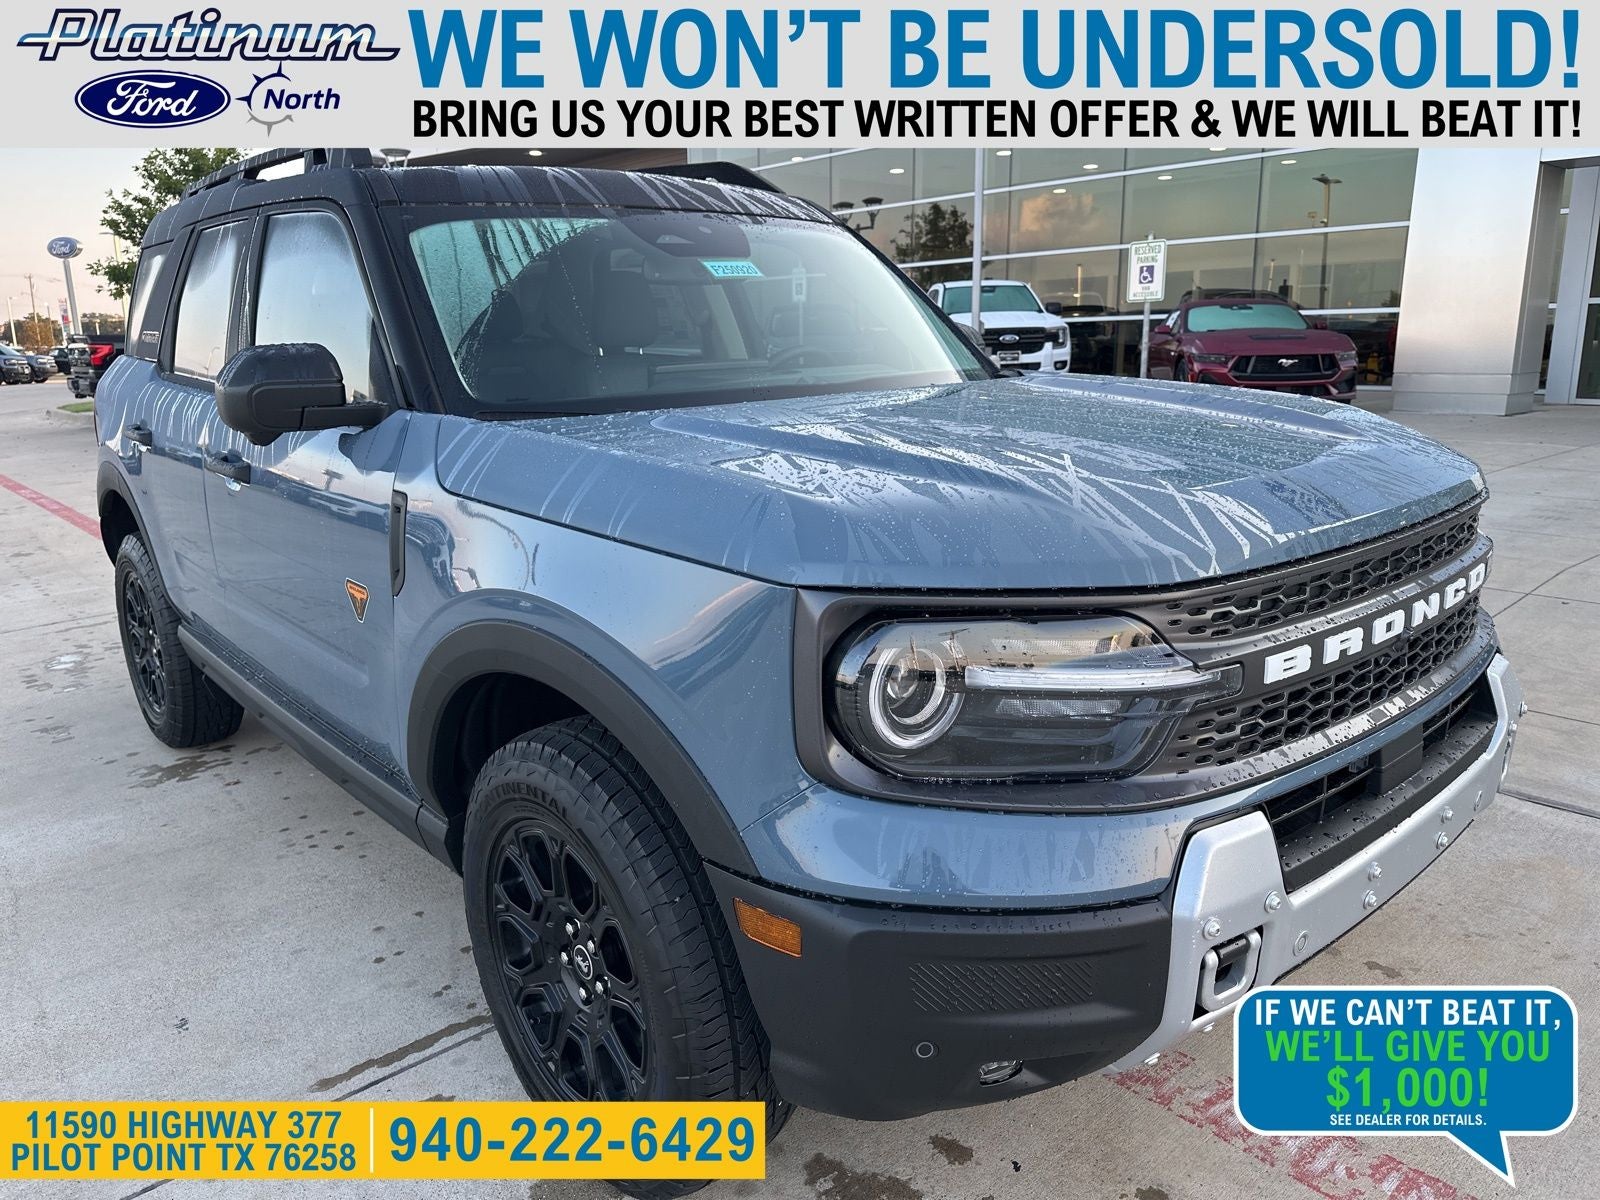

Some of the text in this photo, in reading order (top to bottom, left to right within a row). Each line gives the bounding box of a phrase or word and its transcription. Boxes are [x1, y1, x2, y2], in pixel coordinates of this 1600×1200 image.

[1134, 245, 1162, 255] RESERVED
[1136, 255, 1159, 264] PARKING
[710, 264, 758, 276] F250920
[1264, 562, 1486, 684] BRONCO
